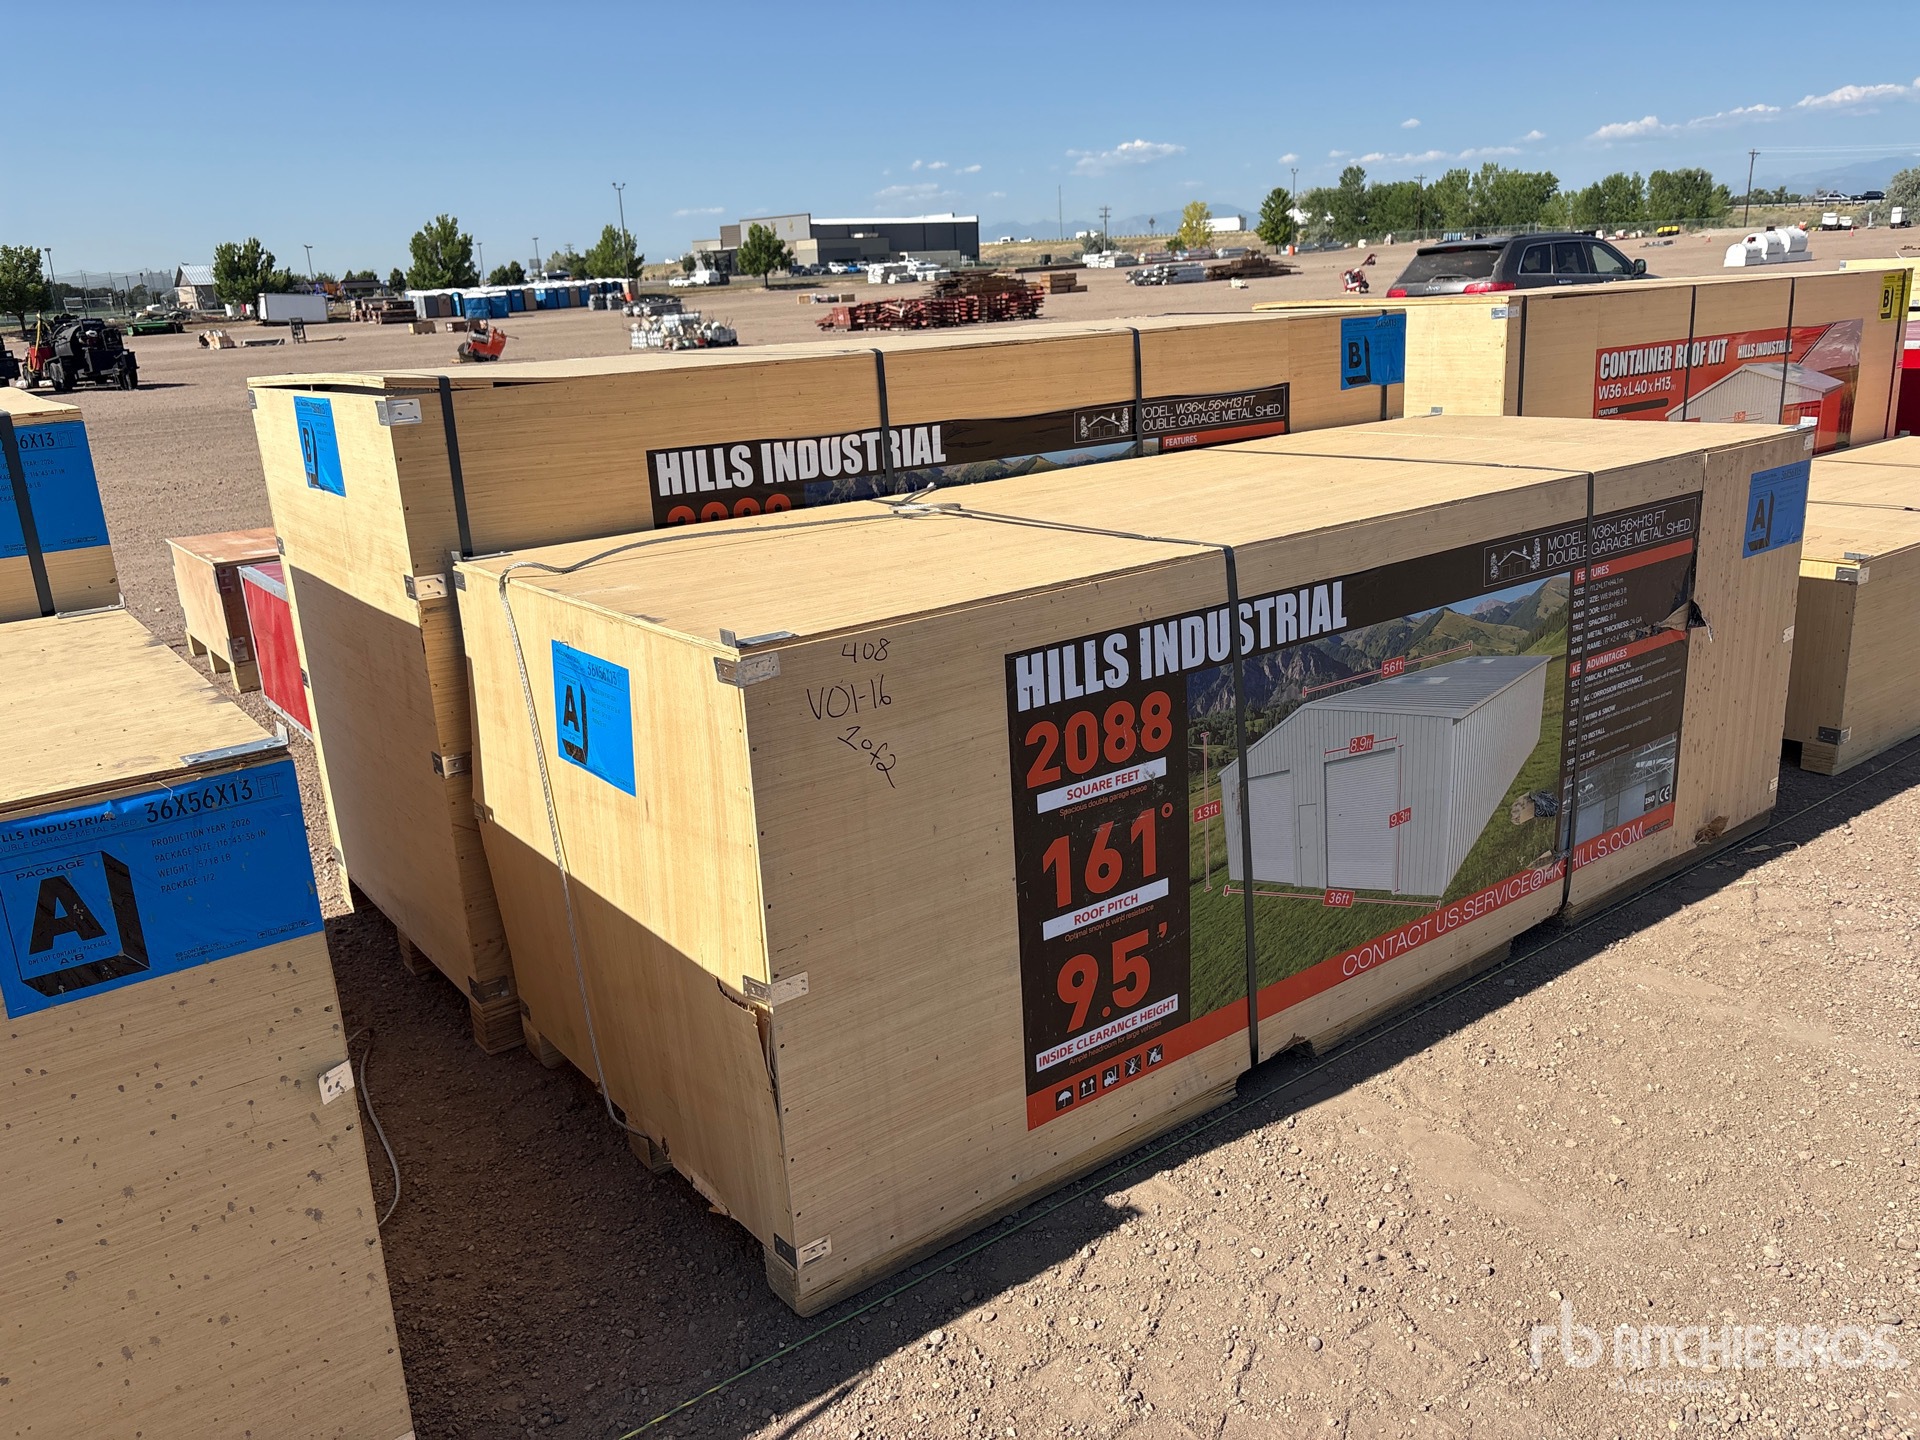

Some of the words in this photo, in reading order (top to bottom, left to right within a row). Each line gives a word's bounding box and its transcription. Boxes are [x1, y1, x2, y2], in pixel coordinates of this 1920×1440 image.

[1348, 341, 1362, 369] B
[1600, 345, 1673, 380] CONTAINER
[1708, 338, 1728, 364] KIT
[1738, 343, 1755, 359] HILLS
[1756, 338, 1793, 356] INDUSTRIL
[1243, 394, 1256, 407] FT
[1142, 416, 1176, 432] OUBLE
[1178, 412, 1220, 427] GARAGE
[1222, 407, 1254, 422] METAL
[1255, 403, 1281, 417] SHED
[1165, 434, 1198, 448] FEATURES
[655, 445, 755, 497] HILLS
[761, 424, 948, 486] INDUSTRIAL
[1655, 509, 1667, 524] FT
[1751, 498, 1766, 532] A
[1547, 544, 1587, 567] DOUBLE
[1591, 532, 1633, 555] GARAGE
[1634, 526, 1665, 544] METAL
[1666, 518, 1691, 536] SHED
[1577, 564, 1610, 581] FETURES
[1573, 599, 1585, 608] DOO
[1015, 633, 1131, 713] HILLS
[1139, 580, 1348, 681] INDUSTRIAL
[1586, 640, 1602, 651] RAME:
[1587, 630, 1604, 639] METAL
[841, 637, 891, 662] 408
[1572, 663, 1582, 674] KE
[1585, 648, 1628, 670] ADVANTAGES
[1383, 660, 1403, 675] 56ft
[1607, 661, 1632, 674] PRACTICAL
[1590, 685, 1617, 700] CORROSION
[1616, 675, 1644, 691] RESISTANCE
[563, 684, 580, 733] A
[1024, 690, 1173, 790] 2088
[1350, 736, 1373, 752] 8.9ft
[1588, 726, 1605, 739] INSTALL
[1586, 748, 1596, 759] LIFE
[144, 779, 253, 823] 36X56X13
[255, 772, 281, 799] FT
[1066, 777, 1113, 801] SQUARE
[1115, 769, 1140, 786] FEET
[1059, 801, 1088, 817] Spacious
[1088, 795, 1109, 808] double
[1109, 790, 1130, 803] garage
[1130, 783, 1148, 797] space
[1197, 803, 1218, 820] 13ft
[1, 831, 24, 843] LLS
[29, 814, 117, 838] INDUSTRIA
[1390, 810, 1410, 828] 9.3ft
[31, 832, 74, 847] GARAGE
[76, 825, 108, 839] METAL
[111, 818, 137, 830] SHED
[151, 828, 204, 848] PRODUCTION
[231, 818, 251, 829] 2026
[154, 847, 192, 863] PACKAGE
[257, 829, 267, 838] IN
[221, 853, 232, 863] LB
[16, 859, 85, 881] PACKAGE
[202, 872, 216, 883] 1/2
[1074, 906, 1106, 926] ROOF
[1107, 893, 1139, 914] PITCH
[1328, 891, 1350, 906] 36ft
[28, 874, 108, 955] A
[1064, 927, 1089, 943] Optimal
[1125, 904, 1155, 919] resistance
[51, 948, 76, 961] CONTAIN
[84, 939, 112, 952] PACKAGES
[1342, 919, 1432, 977] CONTACT
[1039, 1043, 1074, 1068] INSIDE
[1076, 1015, 1139, 1051] CLEARANCE
[1140, 998, 1176, 1023] HEIGHT
[1088, 1039, 1118, 1057] headroom
